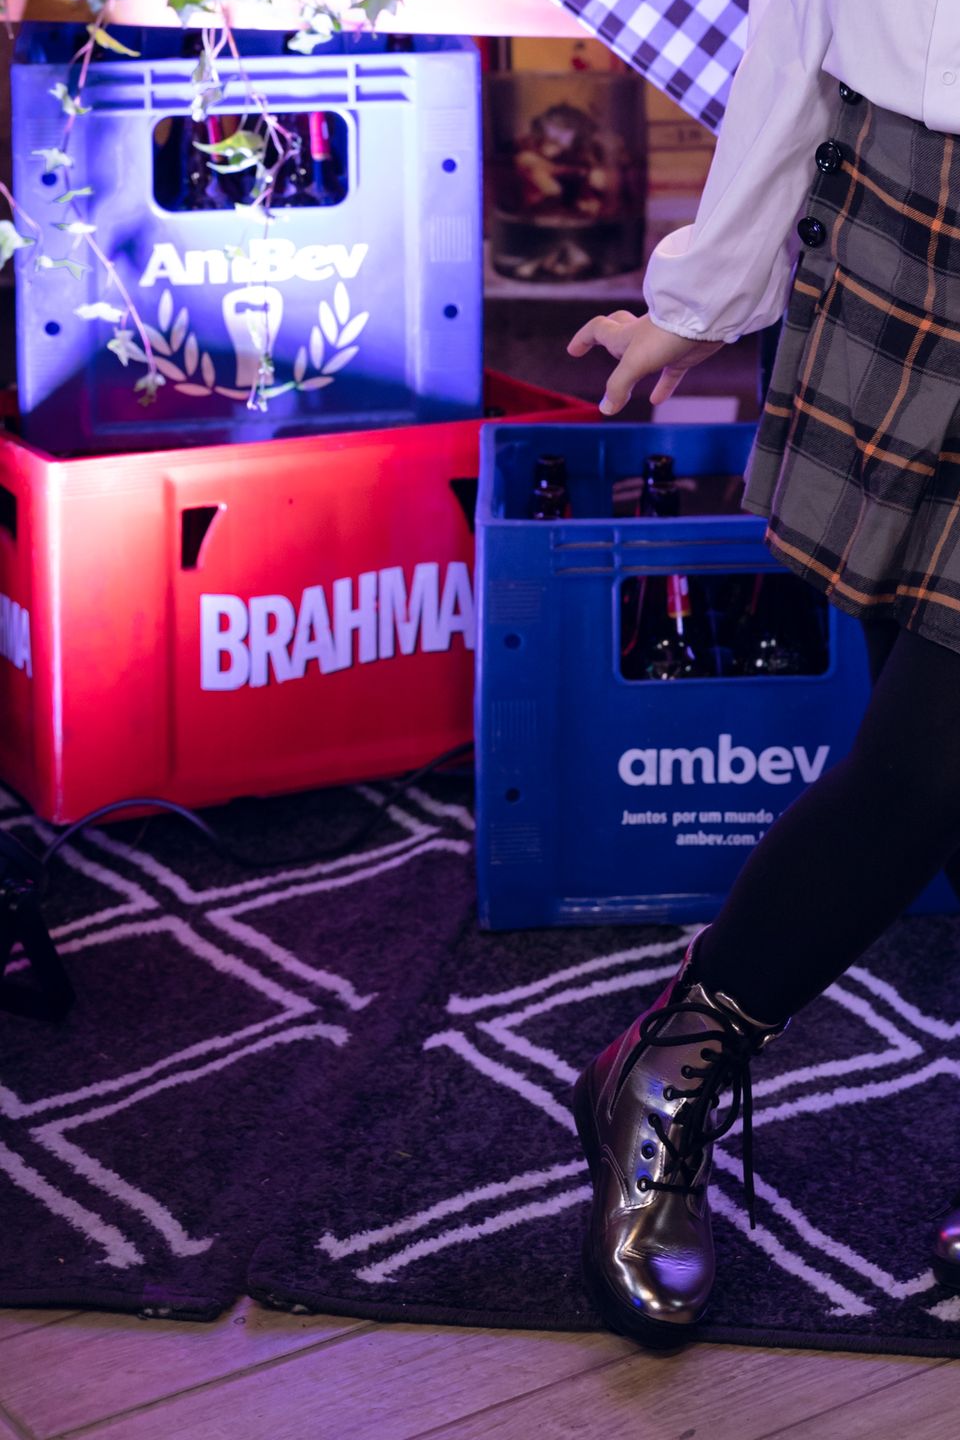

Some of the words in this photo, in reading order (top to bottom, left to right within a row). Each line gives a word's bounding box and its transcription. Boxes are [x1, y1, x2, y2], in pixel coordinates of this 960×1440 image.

[139, 238, 369, 288] AmBev
[200, 561, 476, 692] BRAHMA
[618, 733, 830, 786] ambev
[622, 810, 668, 825] Juntos
[672, 811, 697, 827] por
[698, 811, 722, 823] um
[724, 809, 774, 824] mundo
